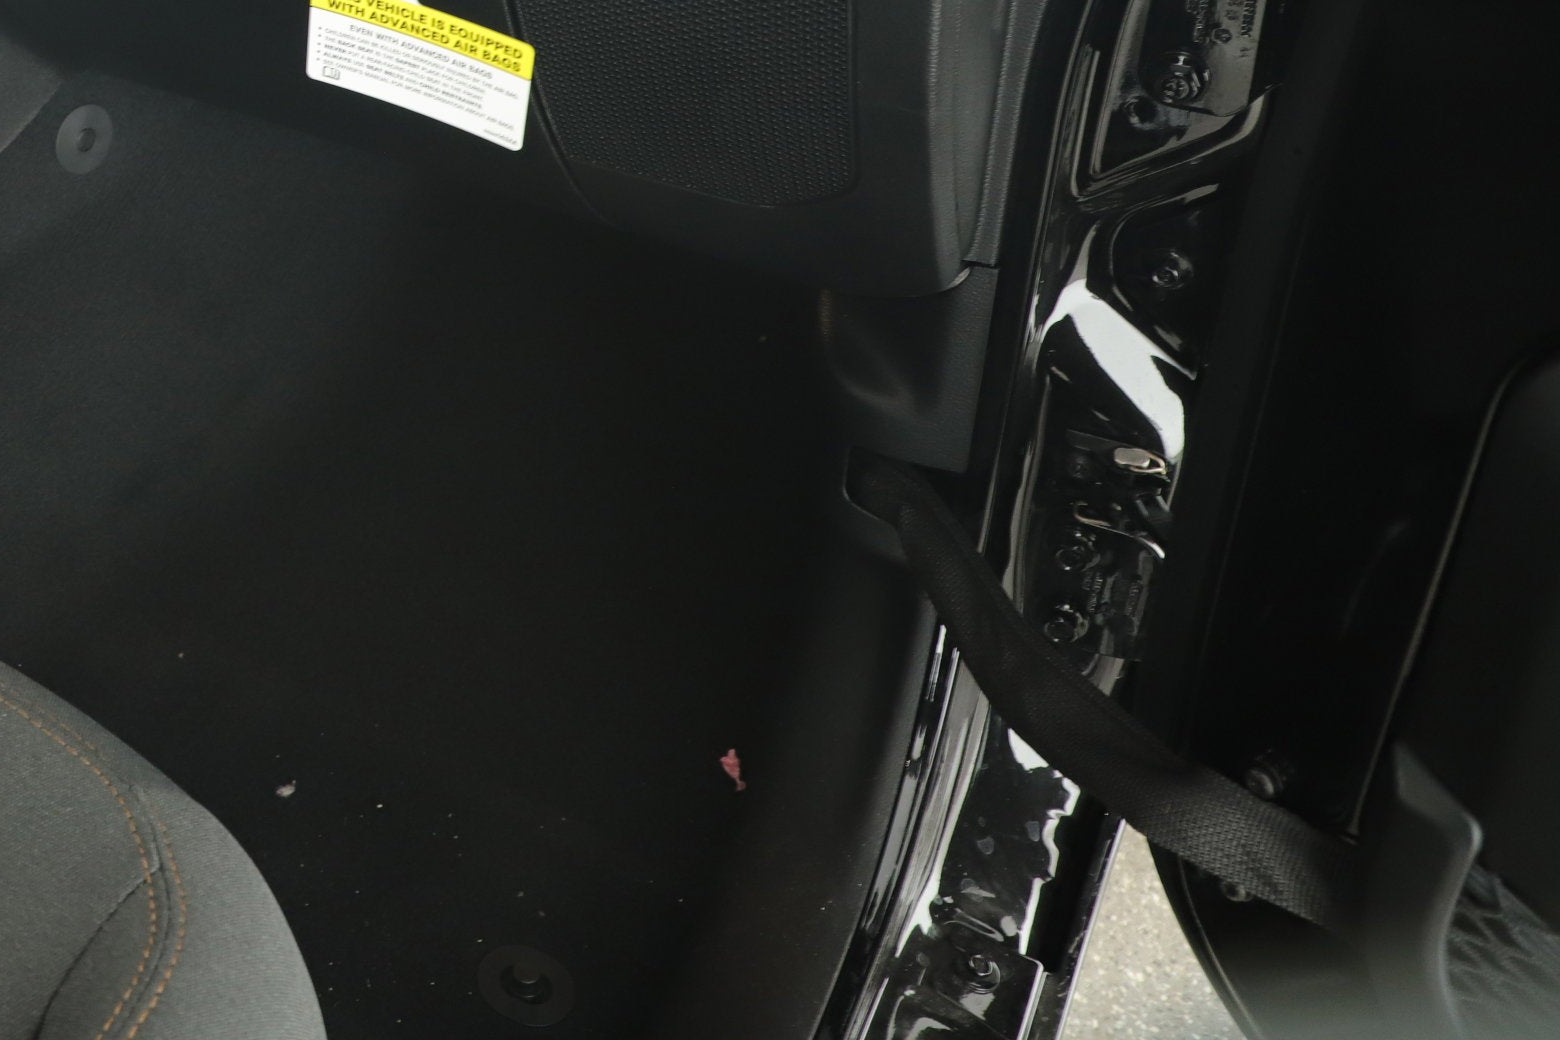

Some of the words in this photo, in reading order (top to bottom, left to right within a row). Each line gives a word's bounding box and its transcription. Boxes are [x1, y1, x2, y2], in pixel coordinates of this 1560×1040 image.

[349, 24, 373, 37] EVEN
[376, 32, 399, 45] WITH
[400, 40, 449, 63] ADVANCED
[451, 58, 466, 69] AIR
[370, 11, 450, 45] ADVANCED
[453, 40, 477, 56] AIR
[482, 50, 521, 72] BAGS
[431, 17, 445, 30] IS
[449, 24, 523, 59] EQUIPPED
